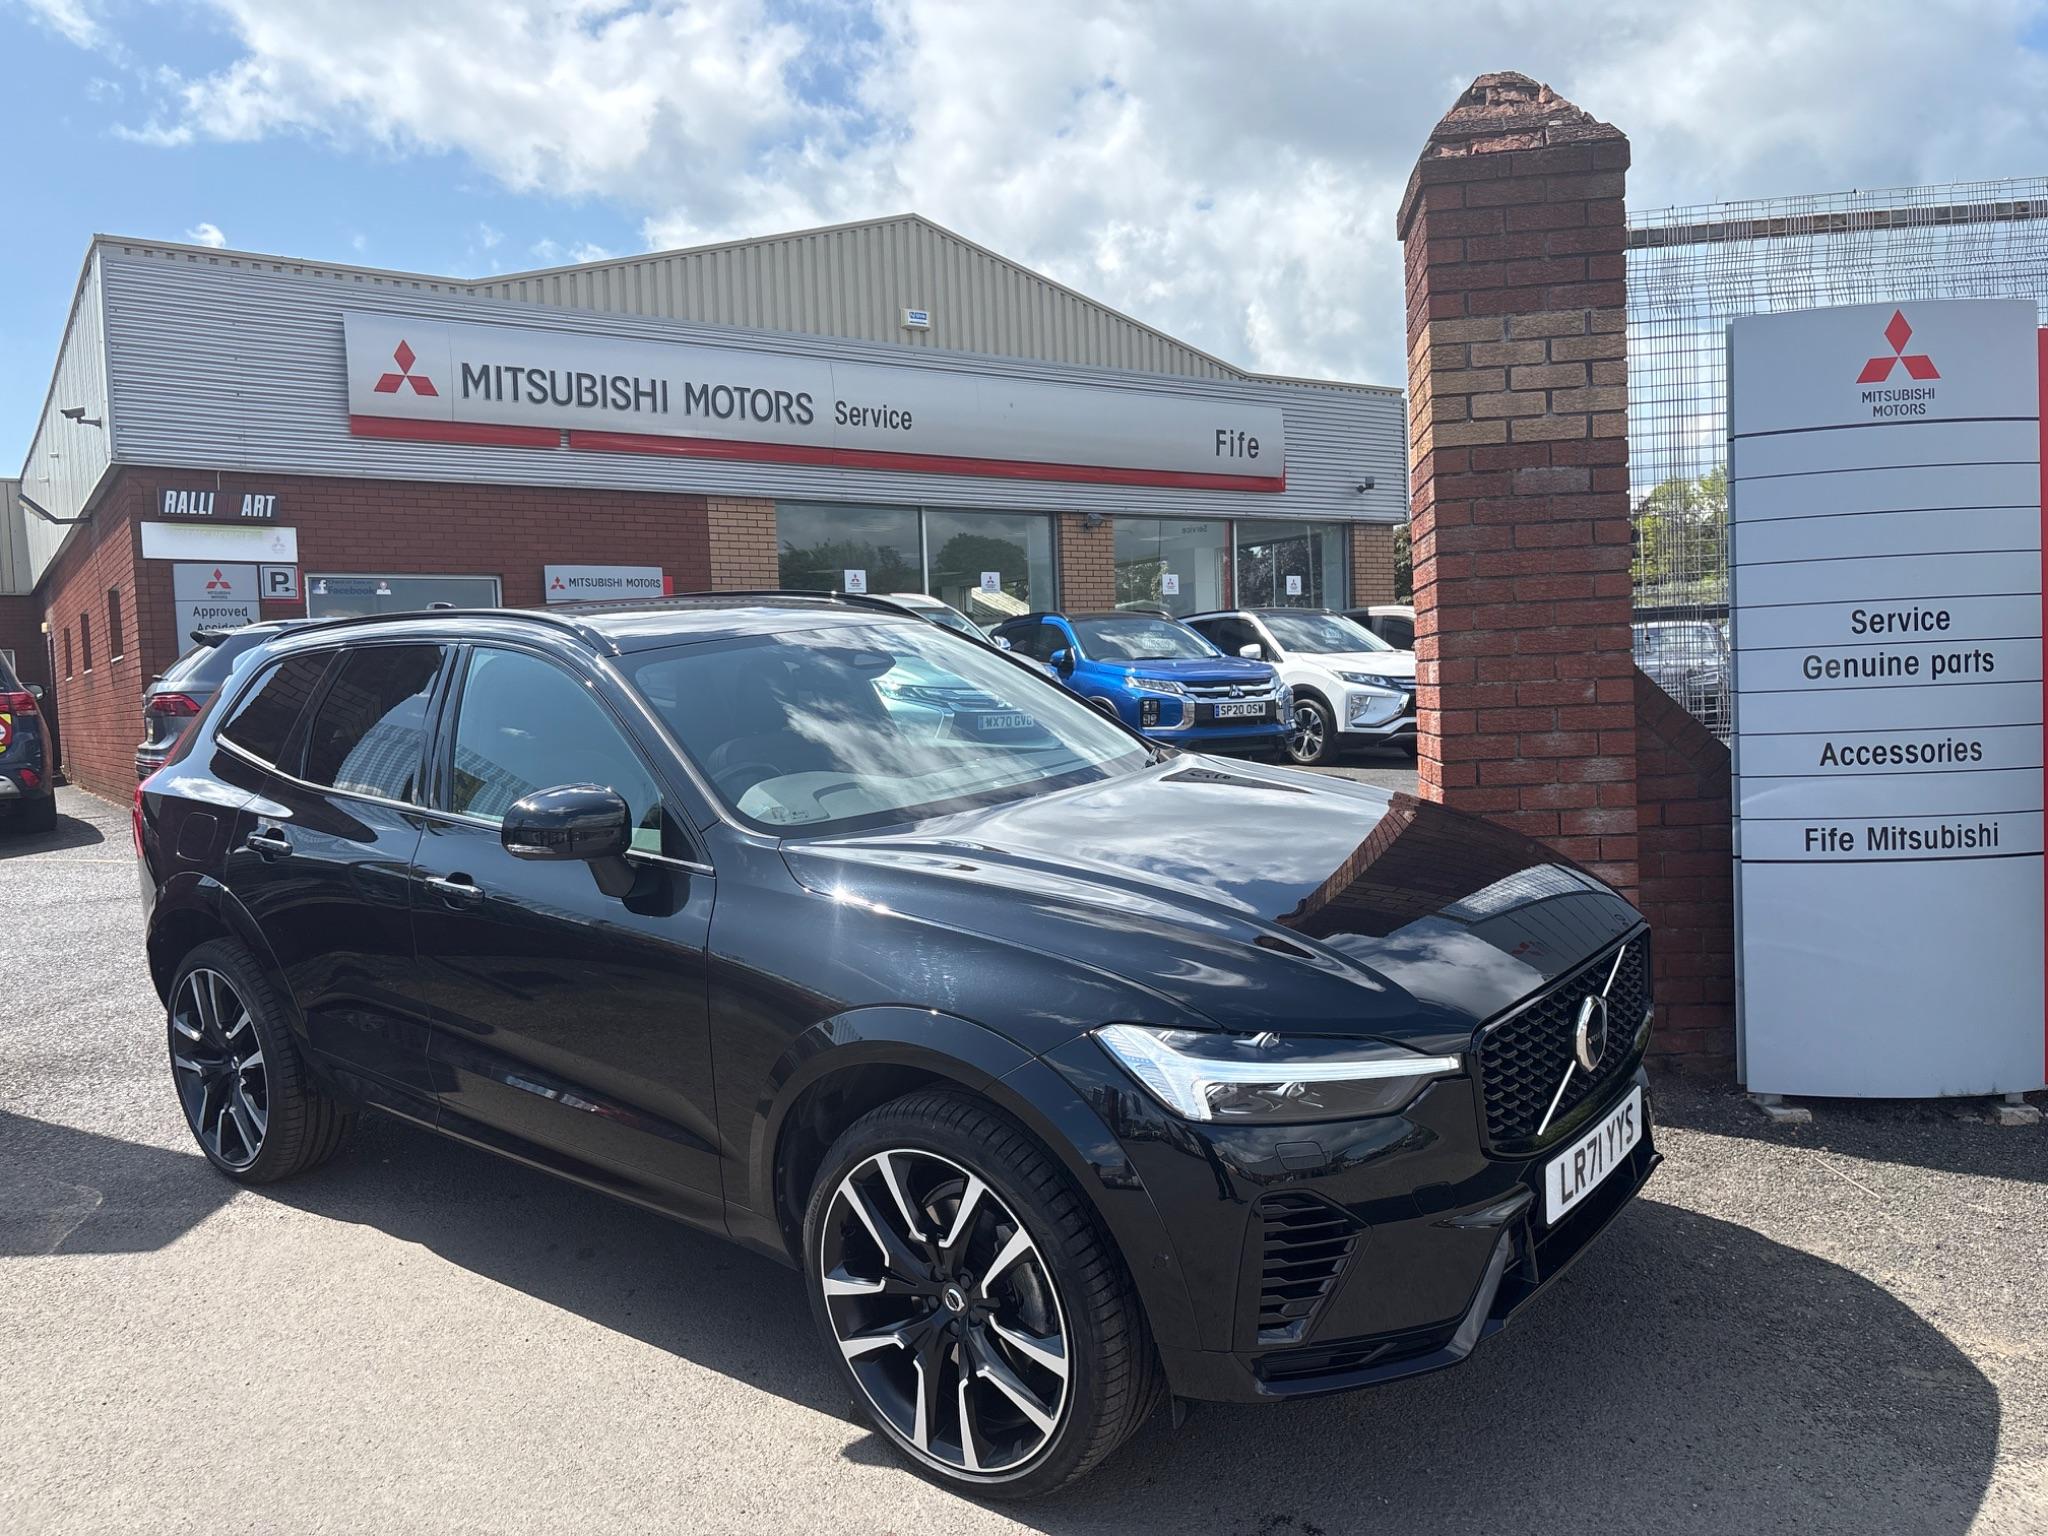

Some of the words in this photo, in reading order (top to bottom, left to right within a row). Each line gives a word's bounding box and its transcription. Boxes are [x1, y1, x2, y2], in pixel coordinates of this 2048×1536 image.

[461, 361, 669, 415] MITSUBISHI
[684, 381, 814, 426] MOTORS
[834, 399, 913, 431] Service
[1861, 387, 1935, 404] MITSUBISHI
[1873, 403, 1926, 418] MOTORS
[1215, 428, 1260, 459] Fife
[163, 490, 215, 515] RALLI
[241, 494, 276, 518] ART
[270, 571, 290, 593] P
[568, 577, 622, 588] MITSUBISHI
[626, 578, 661, 588] MOTORS
[193, 606, 248, 619] Approved
[1851, 606, 1951, 635] Service
[1803, 651, 1920, 679] Genuine
[1931, 648, 1995, 680] parts
[1220, 704, 1244, 715] SP20
[1819, 738, 1983, 766] Accessories
[1804, 826, 1854, 852] Fife
[1867, 822, 1999, 851] Mitsubishi
[1560, 1136, 1603, 1205] LR71
[1606, 1102, 1634, 1163] YYS
